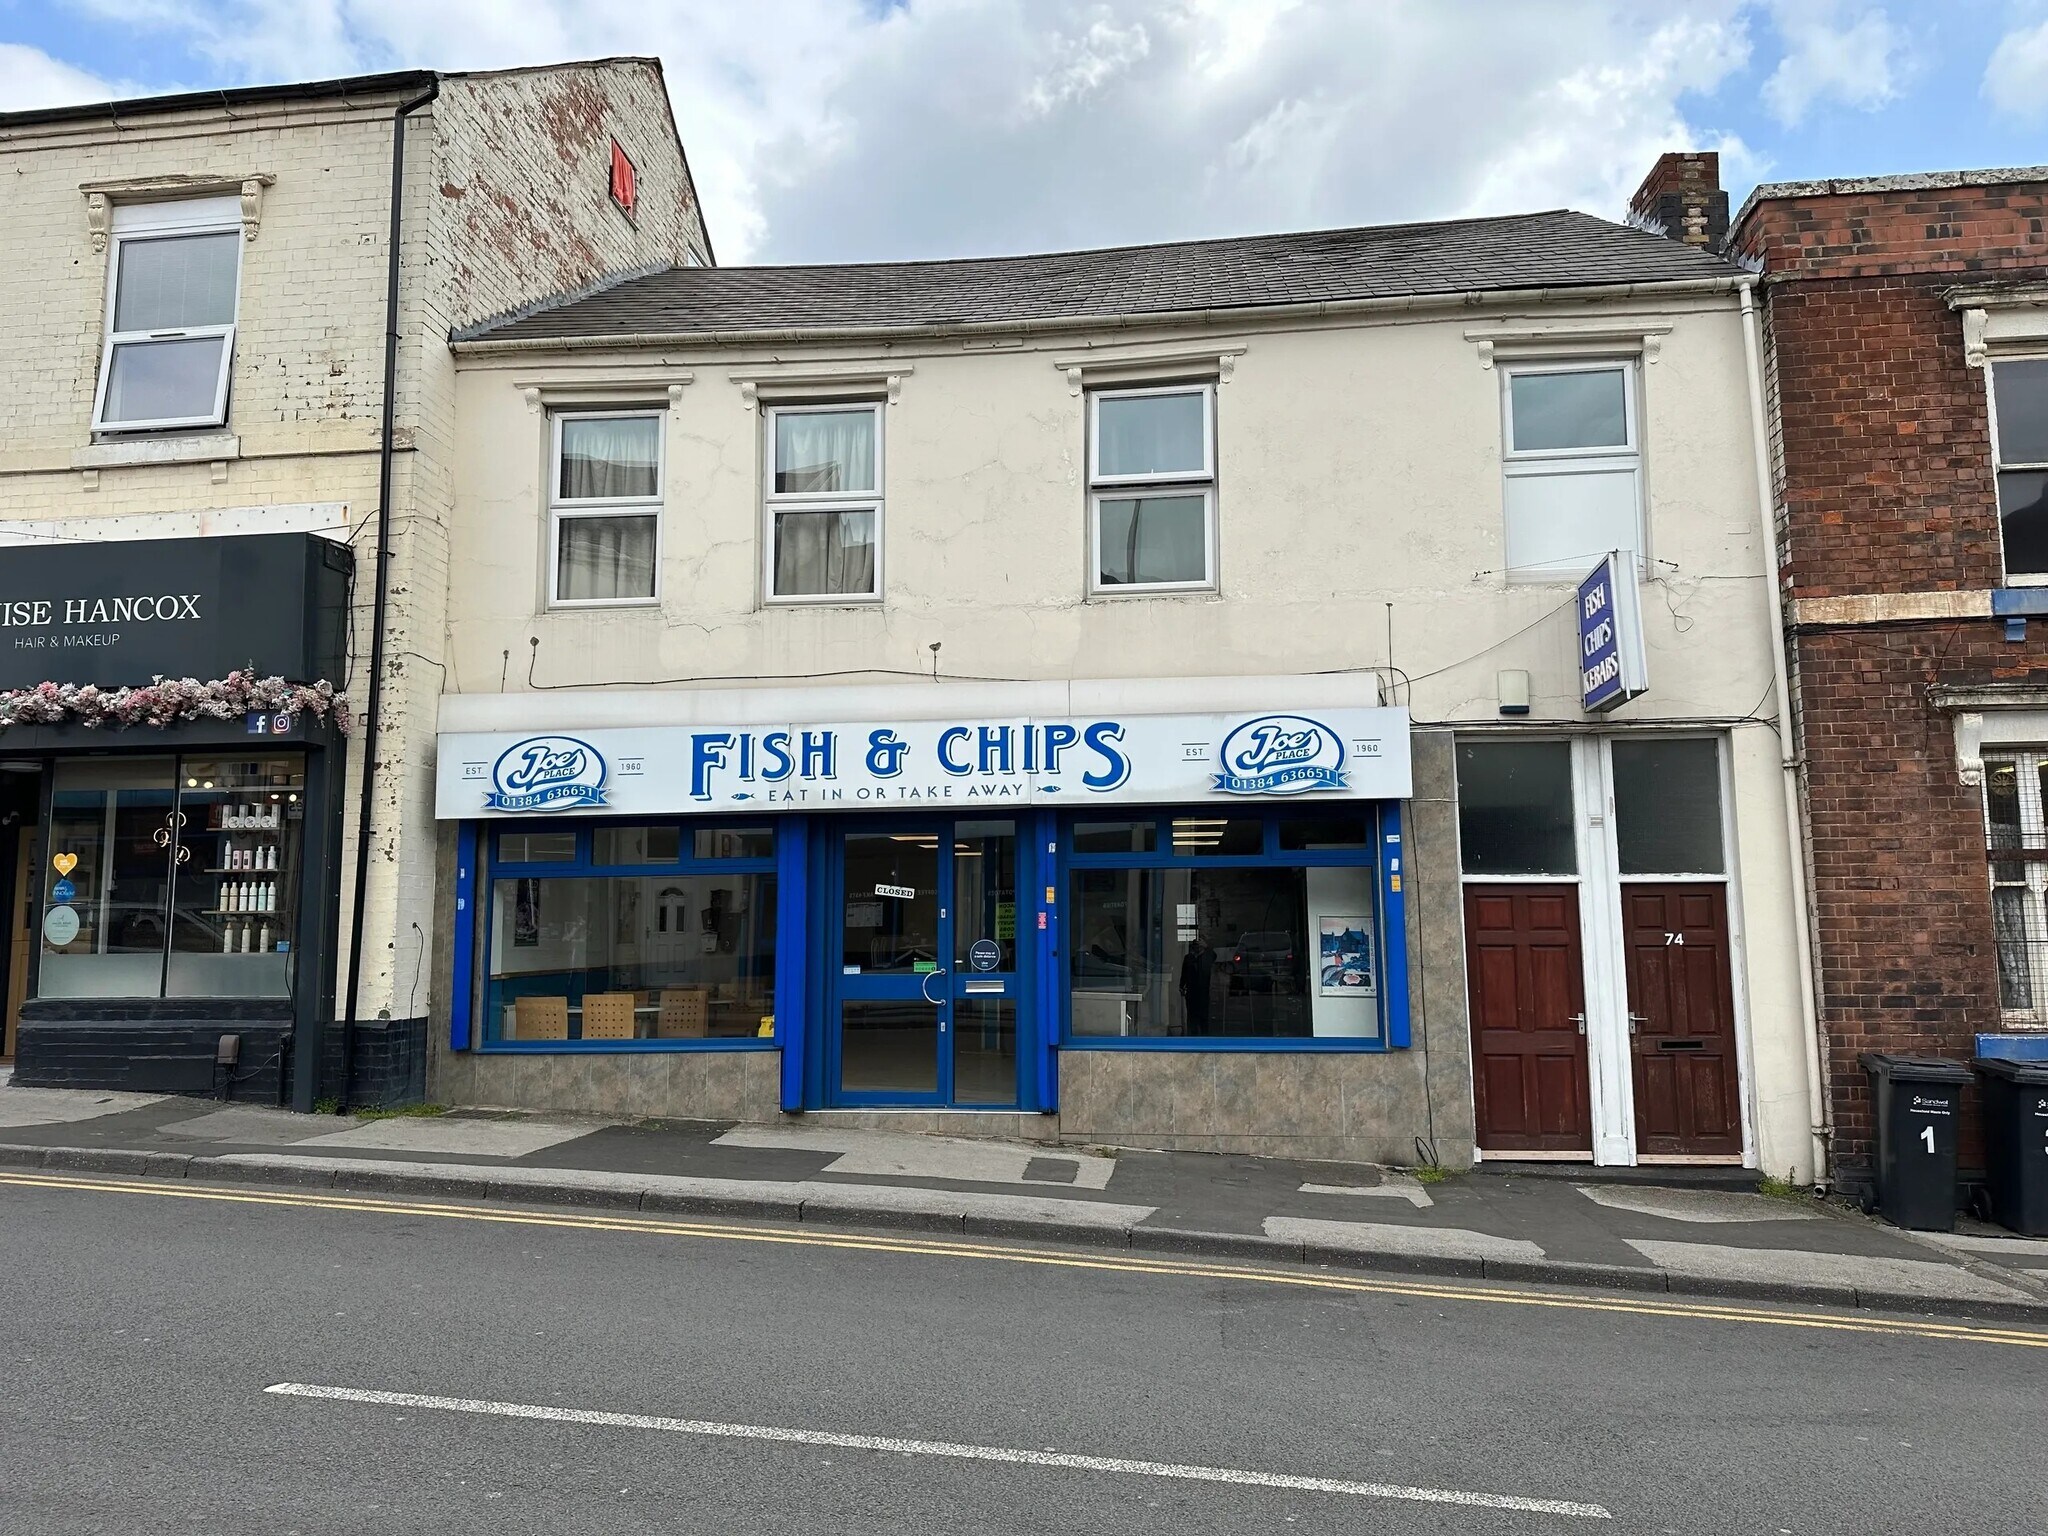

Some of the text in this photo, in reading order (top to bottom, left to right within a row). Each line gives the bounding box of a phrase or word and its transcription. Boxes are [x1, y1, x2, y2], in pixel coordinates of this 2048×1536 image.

[0, 594, 201, 626] ISE HANCOX
[1584, 582, 1606, 619] FISH
[14, 633, 120, 649] HAIR & MAKEUP
[1584, 617, 1612, 657] CHIPS
[1583, 651, 1619, 694] KEBABS
[1186, 744, 1379, 756] EST 1960
[1275, 748, 1310, 760] PLACE
[465, 763, 641, 775] EST 1960
[689, 722, 1132, 801] FISH & CHIPS
[543, 767, 576, 779] PLACE
[1231, 769, 1331, 789] 01384 636651
[502, 786, 593, 807] 01384 636651
[769, 784, 1023, 802] EAT IN OR TAKE AWAY
[876, 886, 913, 897] CLOSED
[1664, 932, 1685, 946] 74
[1920, 1126, 1935, 1154] 1
